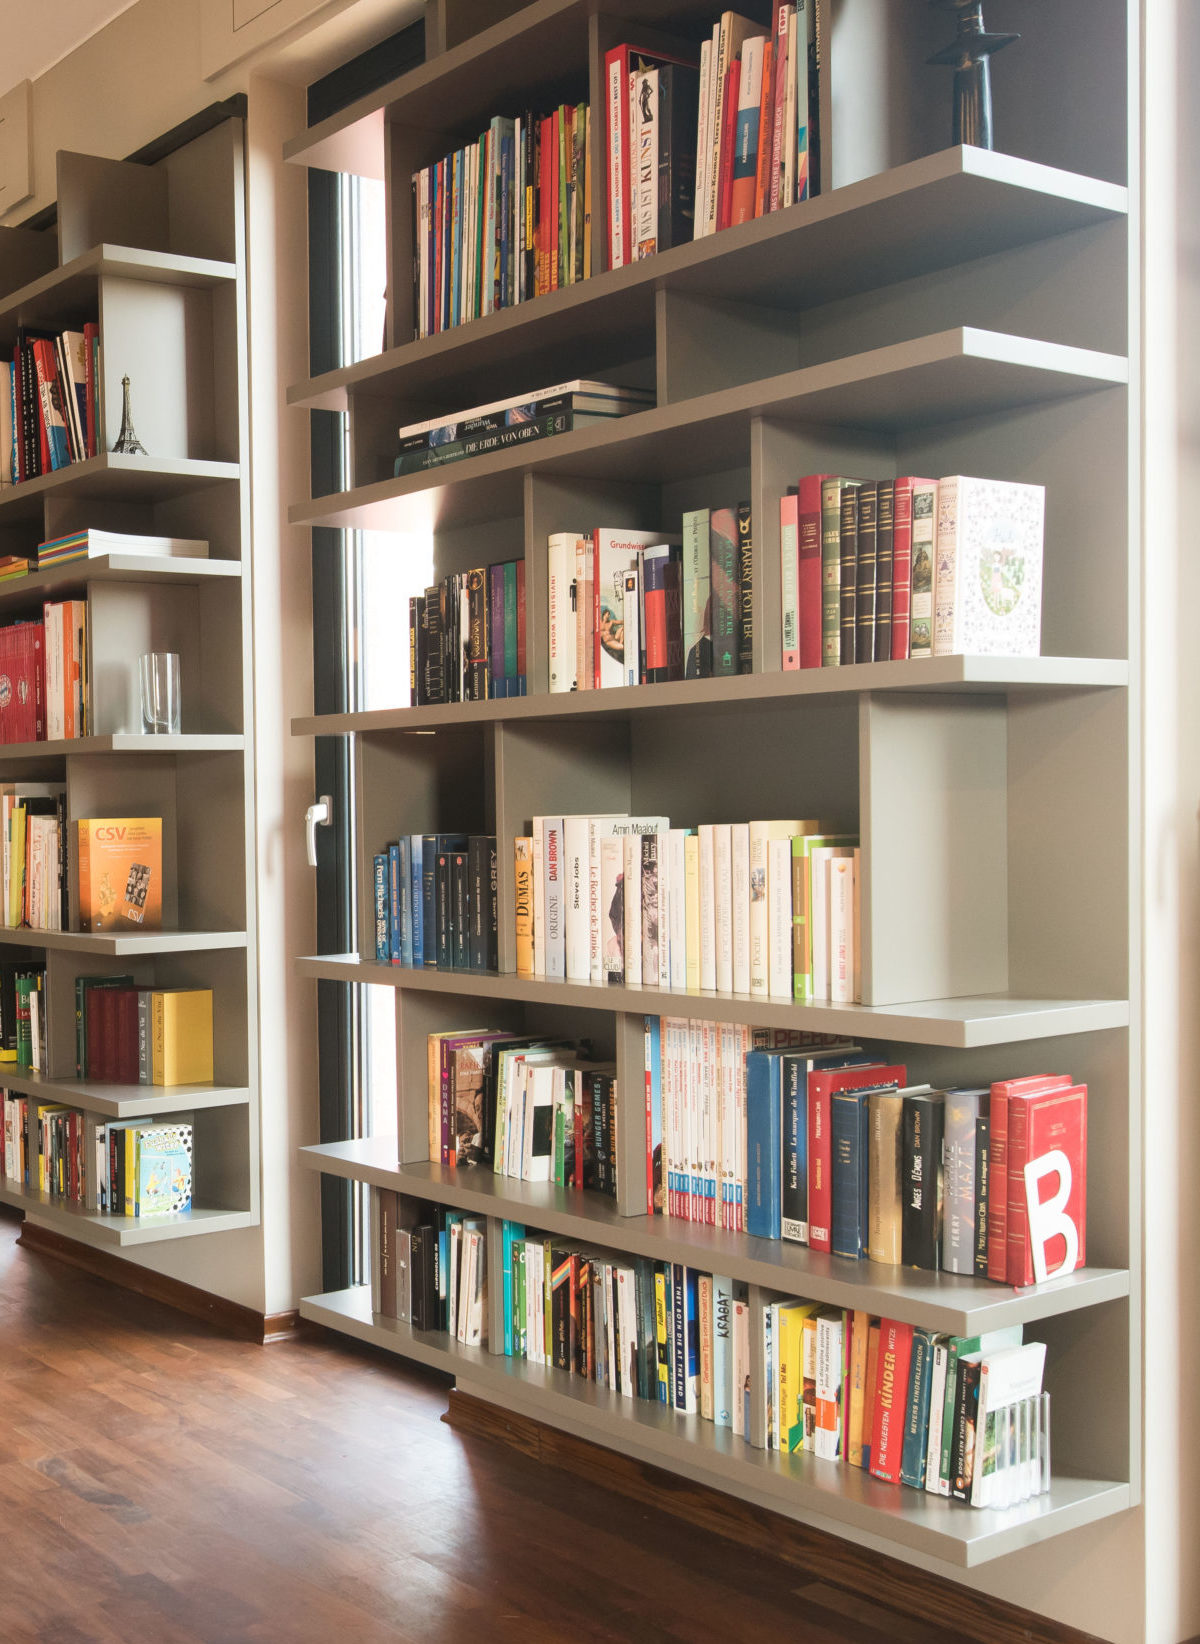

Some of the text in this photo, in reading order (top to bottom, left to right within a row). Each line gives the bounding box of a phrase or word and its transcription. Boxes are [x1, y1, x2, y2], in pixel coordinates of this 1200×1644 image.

[640, 129, 652, 236] WAS IST KUNST
[711, 151, 719, 186] Kosmos
[771, 165, 779, 195] CLEVERE
[709, 190, 717, 221] Kinder
[770, 196, 778, 211] DAS
[466, 425, 540, 453] DIE ERDE VON OBEN
[724, 540, 734, 636] HARRY POTTER
[741, 538, 753, 640] HARRY POTTER
[95, 827, 127, 841] CSV
[611, 822, 659, 835] Amin Maalouf
[642, 841, 650, 866] Michel
[548, 829, 559, 940] ORIGINE DAN BROWN
[590, 866, 599, 878] Le
[377, 865, 385, 919] Fern Michaels
[516, 871, 529, 916] DUMAS
[590, 880, 600, 911] Rocher
[127, 908, 145, 924] CSV
[590, 912, 600, 927] de
[590, 929, 600, 960] Tanios
[753, 935, 761, 967] DOCILE
[140, 1053, 146, 1062] Le
[593, 1082, 602, 1148] HUNGER GAMES
[789, 1063, 800, 1189] Ken Follett La marque de Windfield
[911, 1154, 922, 1182] DÉMONS
[958, 1146, 973, 1201] MAZE
[911, 1188, 922, 1210] ANGES
[978, 1202, 987, 1217] Clark
[951, 1214, 960, 1248] PERRY
[1023, 1150, 1079, 1287] B
[675, 1285, 683, 1305] THEY
[701, 1280, 709, 1298] Duck
[701, 1299, 709, 1324] Donald
[717, 1289, 730, 1339] KRABAT
[676, 1348, 682, 1361] AT
[702, 1338, 710, 1352] Tips
[701, 1353, 710, 1384] Geheime
[879, 1327, 896, 1466] DIE NEUESTEN WITZE
[910, 1344, 923, 1434] MEYERS KINDERLEXIKON
